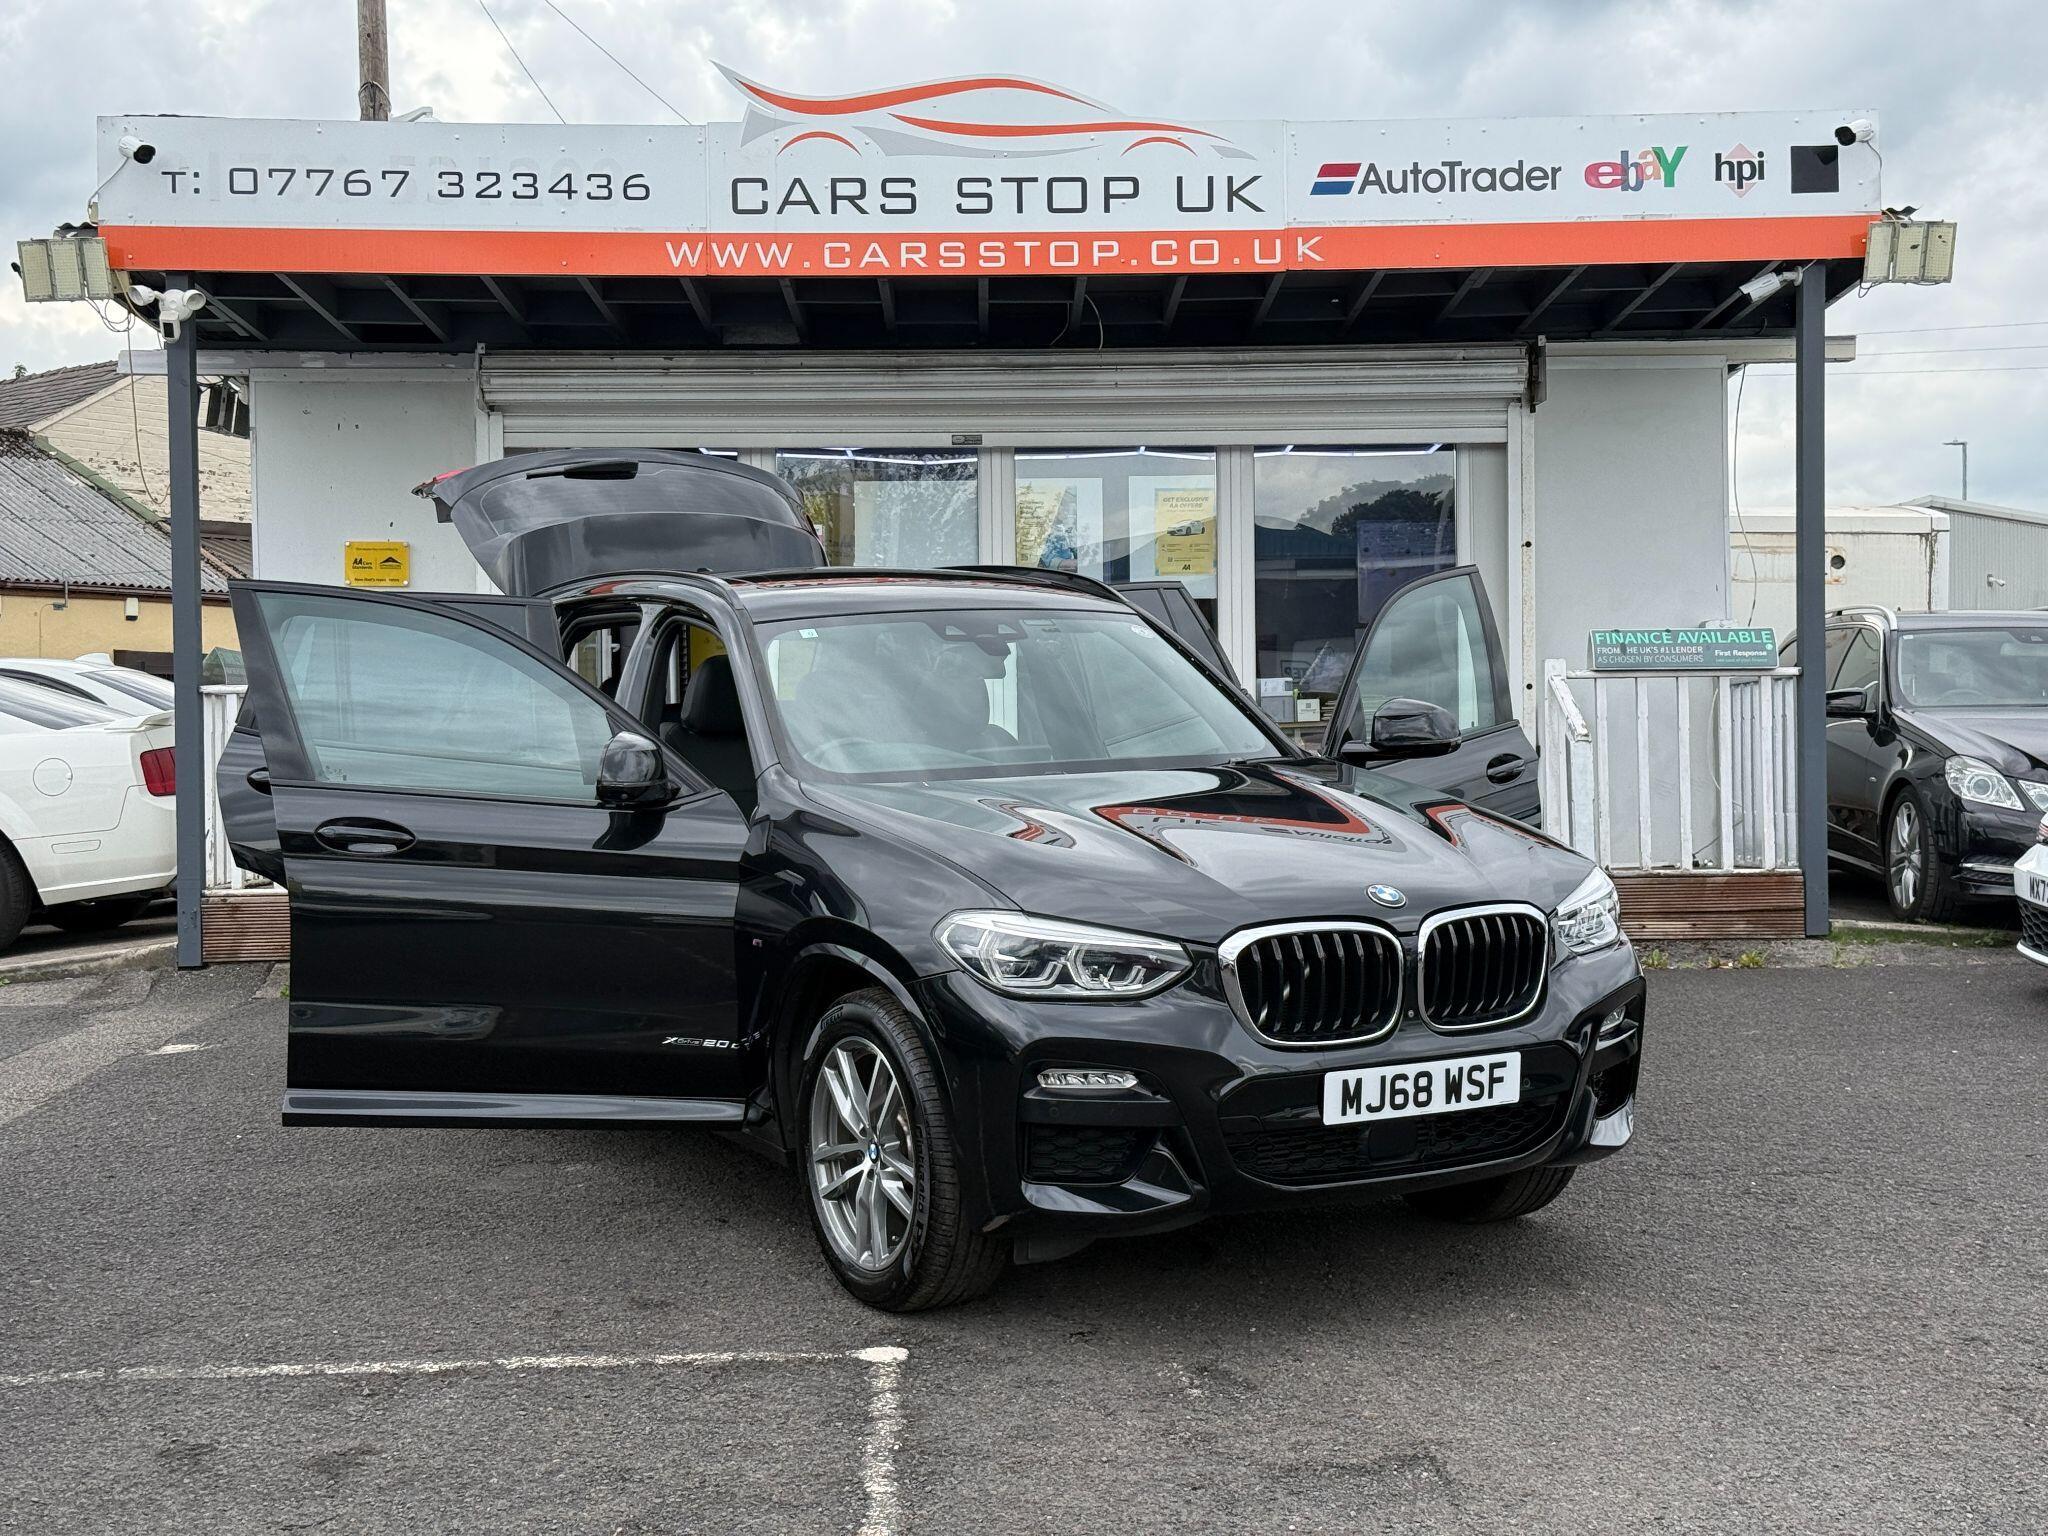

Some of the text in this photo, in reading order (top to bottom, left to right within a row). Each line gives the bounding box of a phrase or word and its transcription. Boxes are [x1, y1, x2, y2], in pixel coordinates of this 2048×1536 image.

[161, 167, 650, 201] T: 07767 323436
[1358, 160, 1562, 195] AutoTrader
[1715, 151, 1765, 189] hpi
[731, 175, 1266, 215] CARS STOP UK
[665, 235, 1325, 269] WWW.CARSSTOP.CO.UK
[352, 558, 363, 566] AA
[1595, 630, 1772, 645] FINANCE AVAILABLE
[2029, 875, 2048, 903] MX7
[1340, 1061, 1508, 1116] MJ68 WSF
